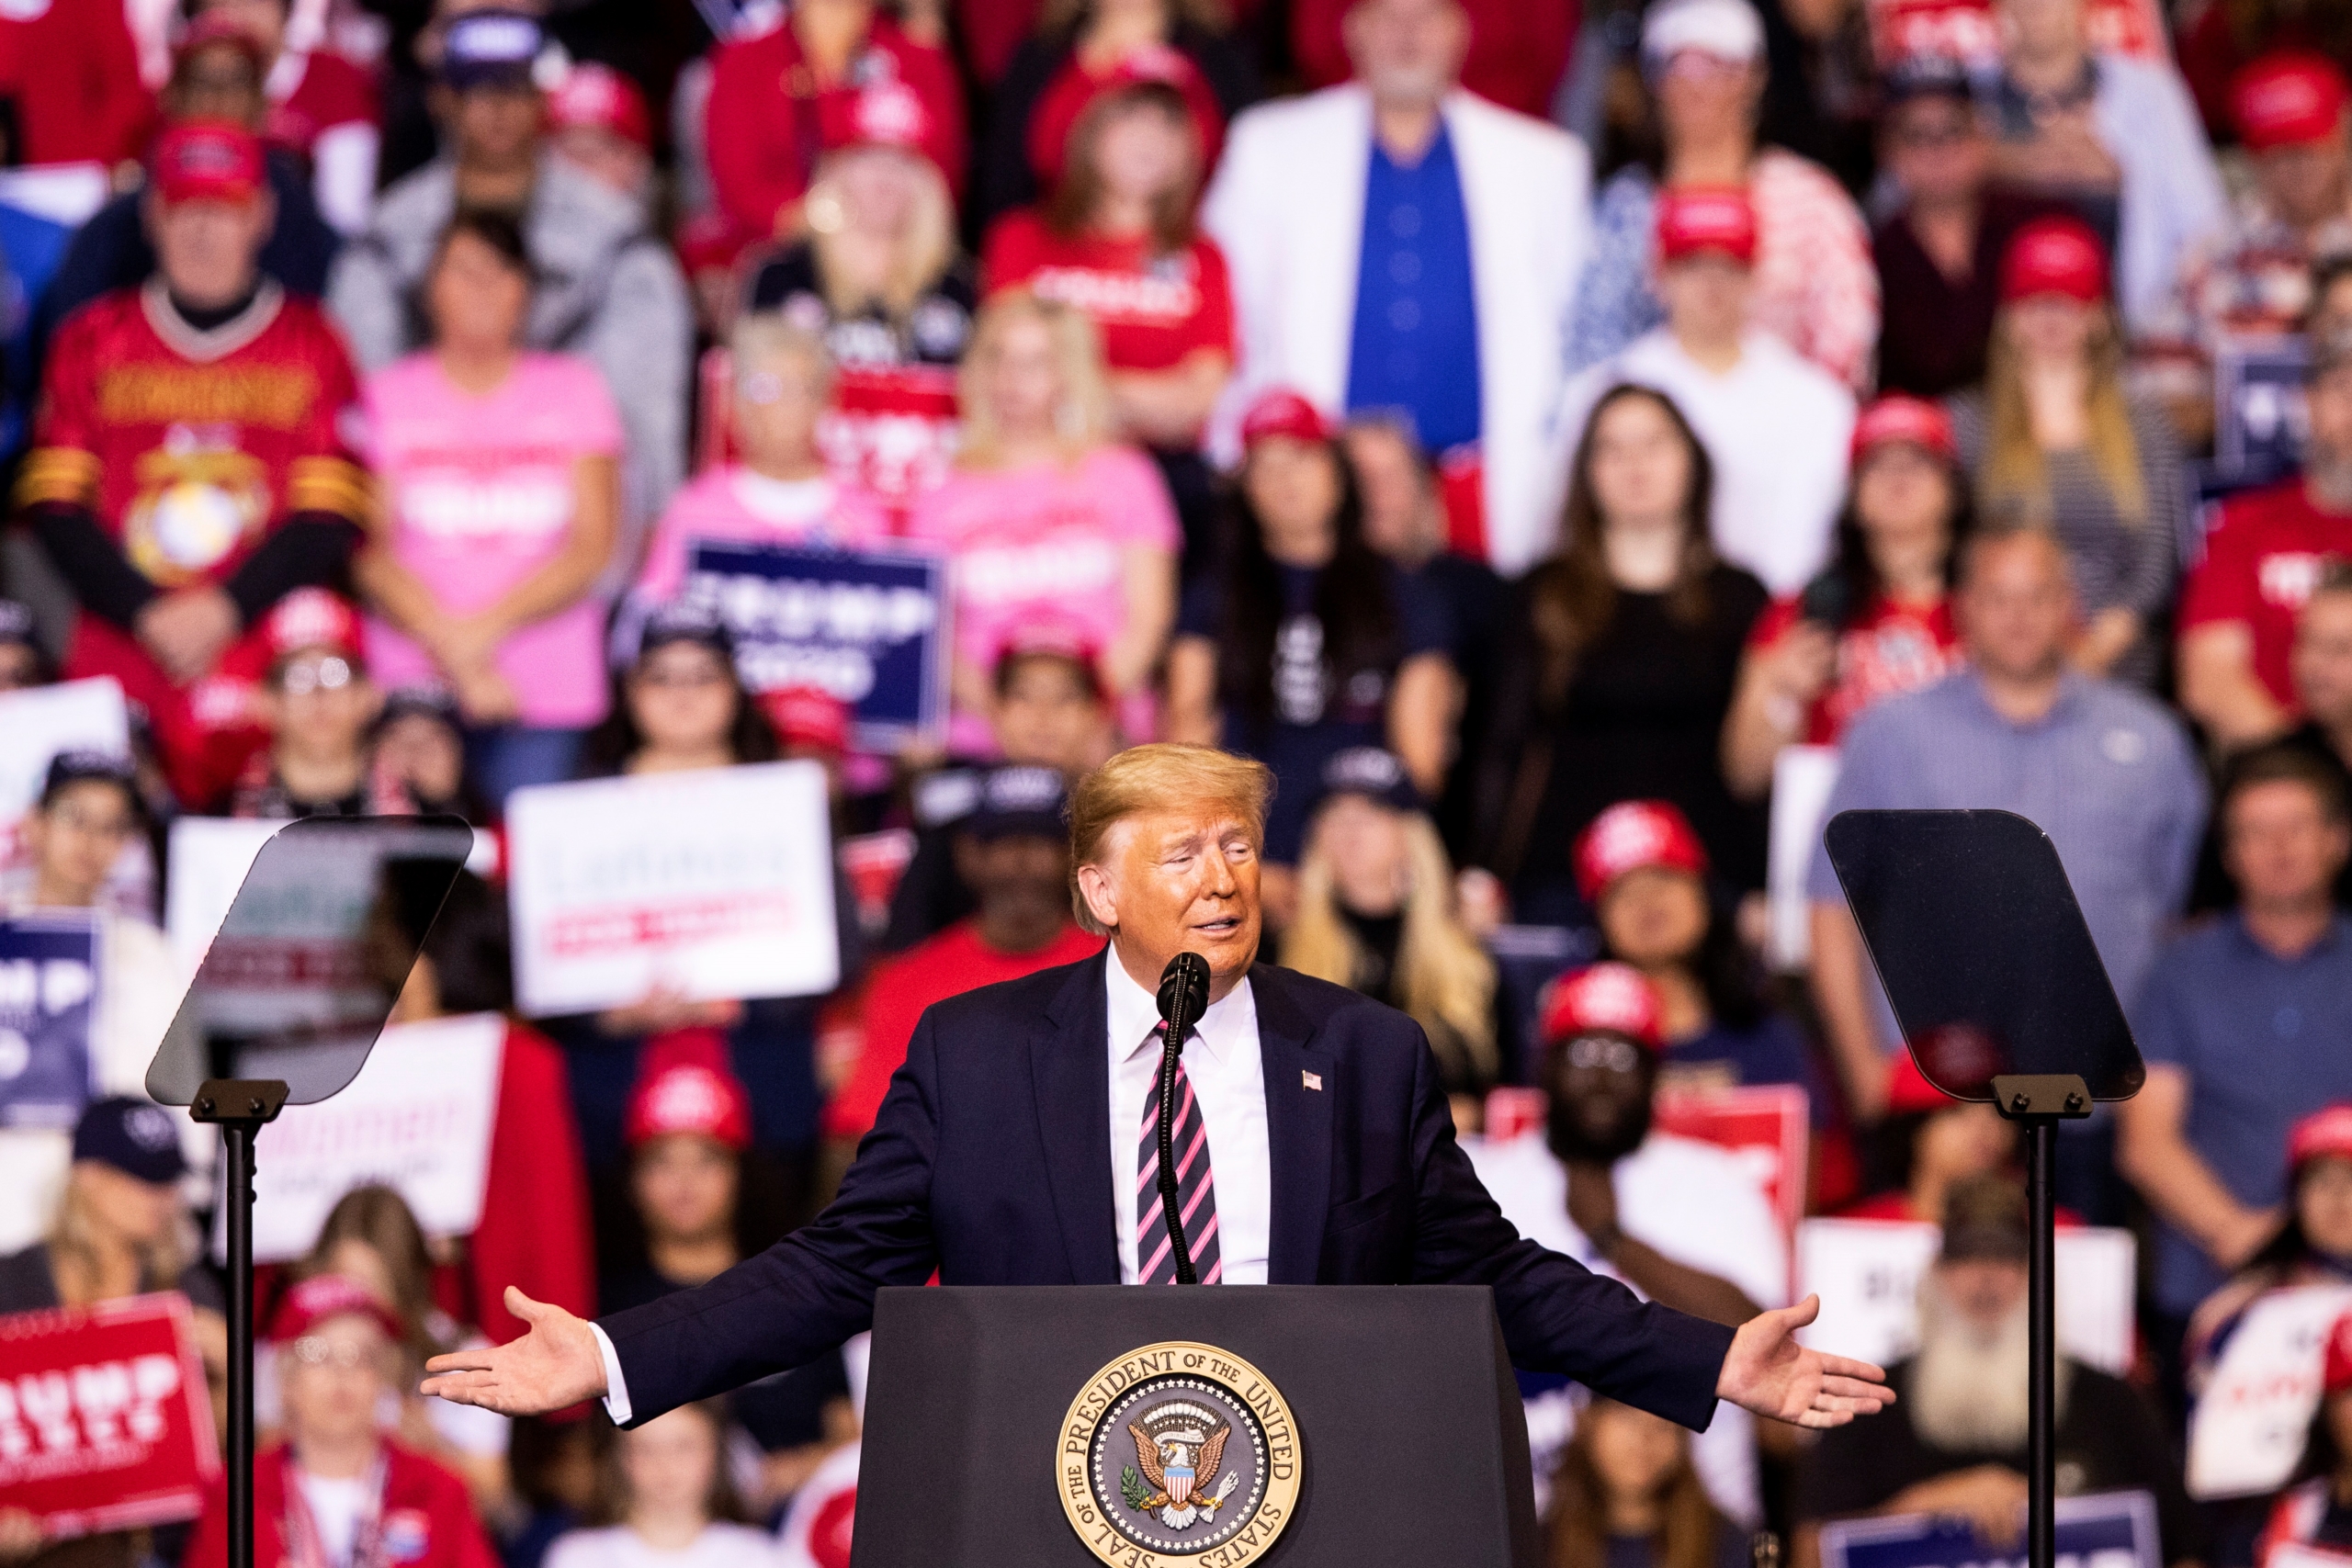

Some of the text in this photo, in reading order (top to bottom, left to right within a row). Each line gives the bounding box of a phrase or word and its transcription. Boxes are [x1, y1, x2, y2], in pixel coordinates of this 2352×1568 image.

[1066, 1350, 1294, 1568] SEAL OF THE PRESIDENT OF THE UNITED STATES
